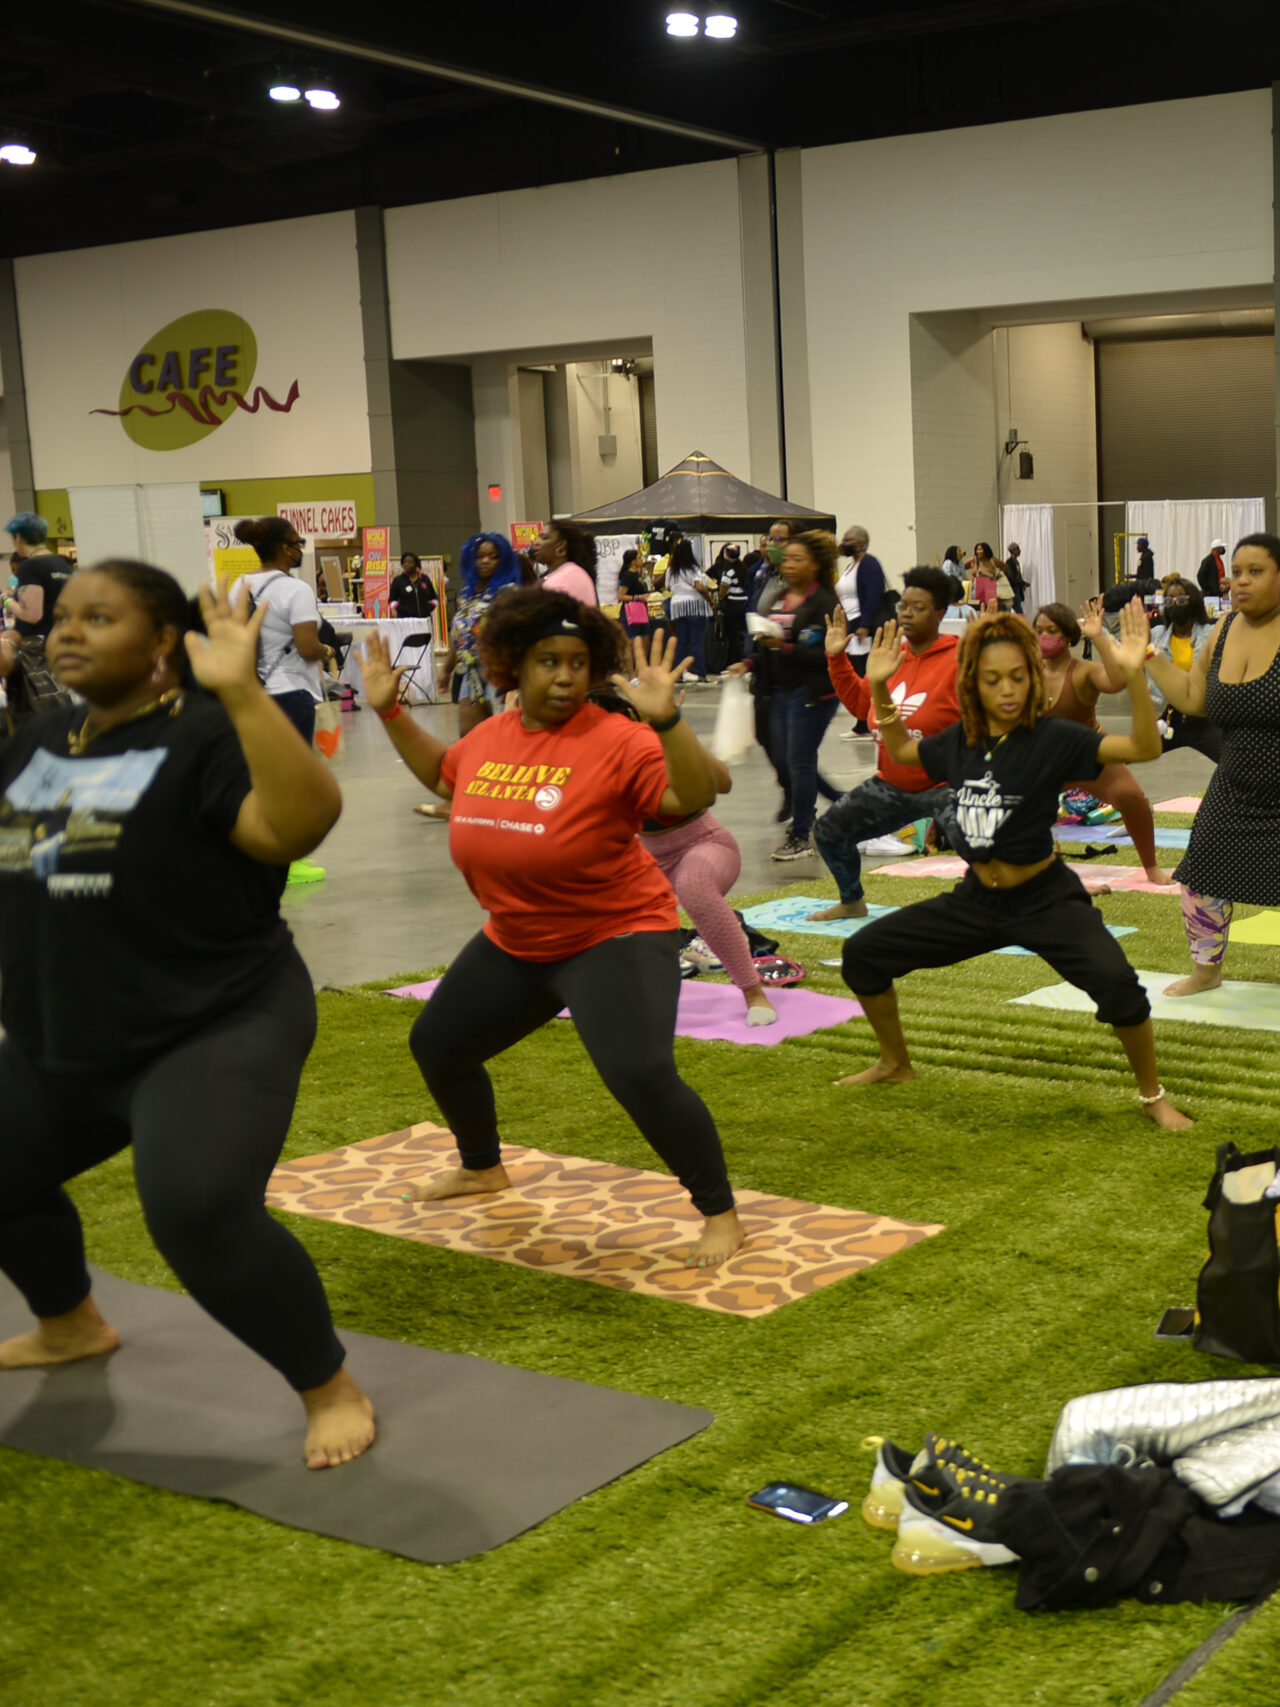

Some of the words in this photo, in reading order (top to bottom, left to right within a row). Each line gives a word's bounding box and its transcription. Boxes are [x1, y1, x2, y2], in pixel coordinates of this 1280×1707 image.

[129, 344, 239, 394] CAFE
[320, 507, 355, 533] CAKES
[366, 560, 387, 571] RISE
[369, 551, 381, 561] ON
[476, 761, 572, 786] BELIEVE
[957, 786, 1002, 806] Uncle
[500, 820, 533, 833] CHASE
